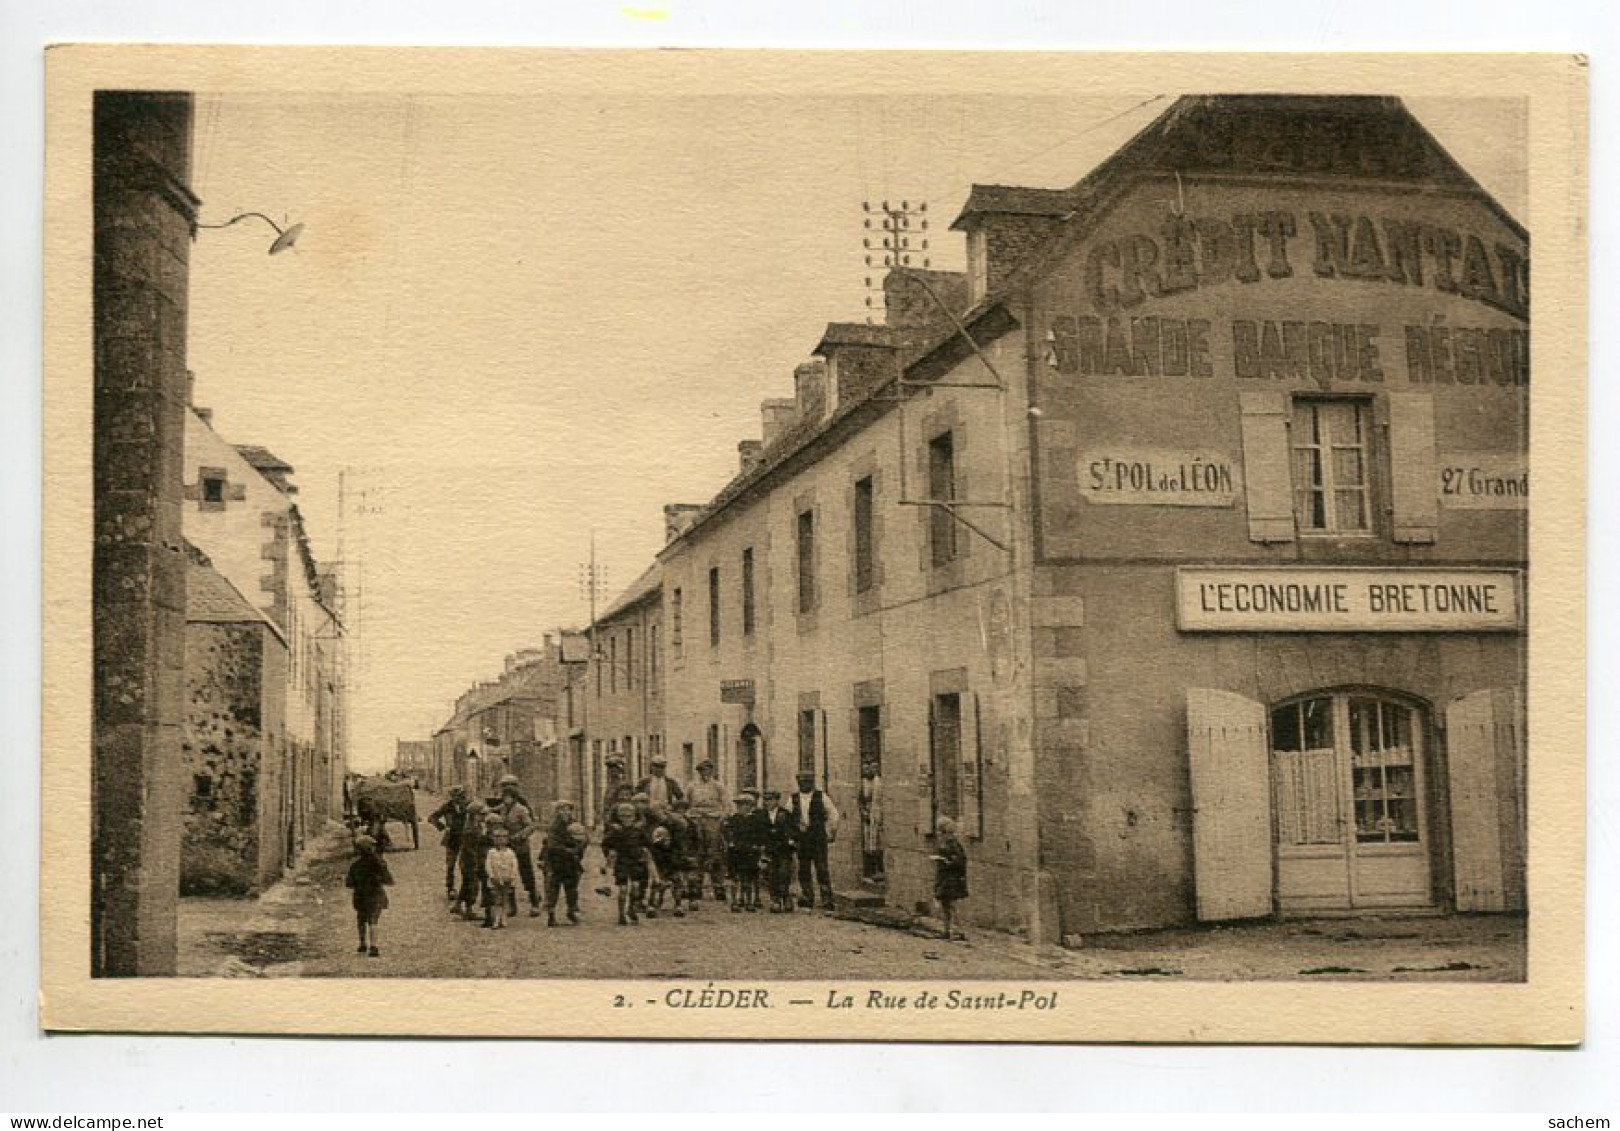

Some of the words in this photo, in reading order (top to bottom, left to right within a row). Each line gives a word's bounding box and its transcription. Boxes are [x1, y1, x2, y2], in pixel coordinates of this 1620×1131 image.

[1085, 211, 1297, 317] CRÉDIT
[1052, 316, 1213, 378] GRANDE
[1233, 319, 1384, 391] BANQUE
[1115, 462, 1158, 491] POL
[1158, 473, 1178, 491] de
[1179, 457, 1232, 492] LÉON
[1442, 467, 1463, 495] 27
[1468, 467, 1528, 496] Grand
[1200, 584, 1349, 613] L'ECONOMIE
[1369, 584, 1498, 613] BRETONNE
